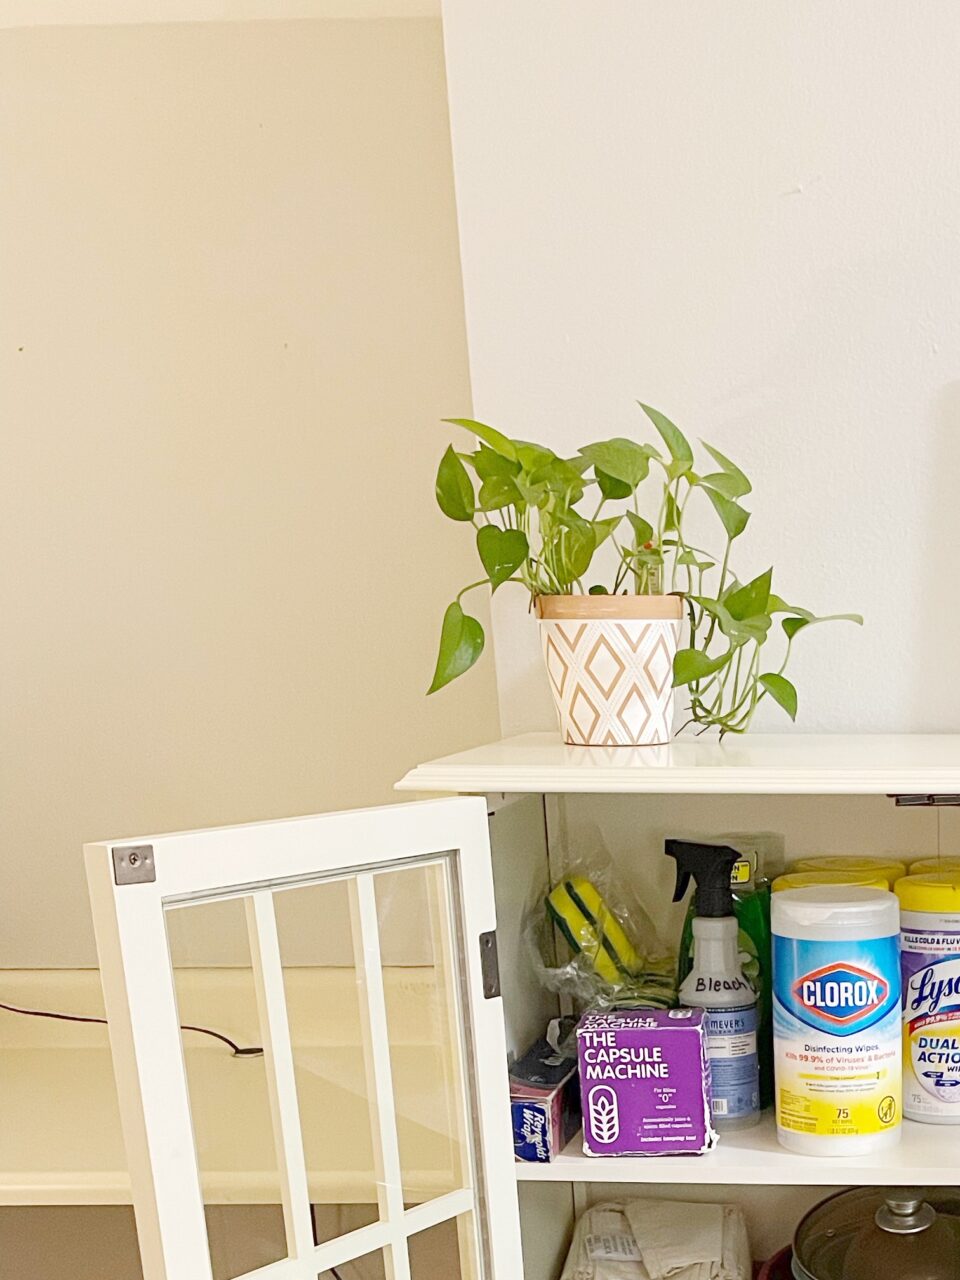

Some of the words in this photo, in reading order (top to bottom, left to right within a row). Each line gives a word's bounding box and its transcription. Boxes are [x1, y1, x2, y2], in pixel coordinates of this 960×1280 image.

[919, 937, 935, 945] COLD
[695, 977, 748, 992] Bleach
[802, 980, 879, 1007] CLOROX
[583, 1021, 659, 1030] MACHINE
[585, 1017, 655, 1025] CAPSULE
[582, 1032, 617, 1047] THE
[918, 1037, 960, 1050] DUAL
[584, 1047, 662, 1063] CAPSULE
[804, 1044, 853, 1054] Disinfecting
[855, 1044, 879, 1052] Wipes
[798, 1054, 824, 1064] 99.9%
[586, 1063, 669, 1079] MACHINE
[912, 1094, 922, 1104] 75
[836, 1108, 849, 1119] 75
[520, 1108, 535, 1138] Wrap
